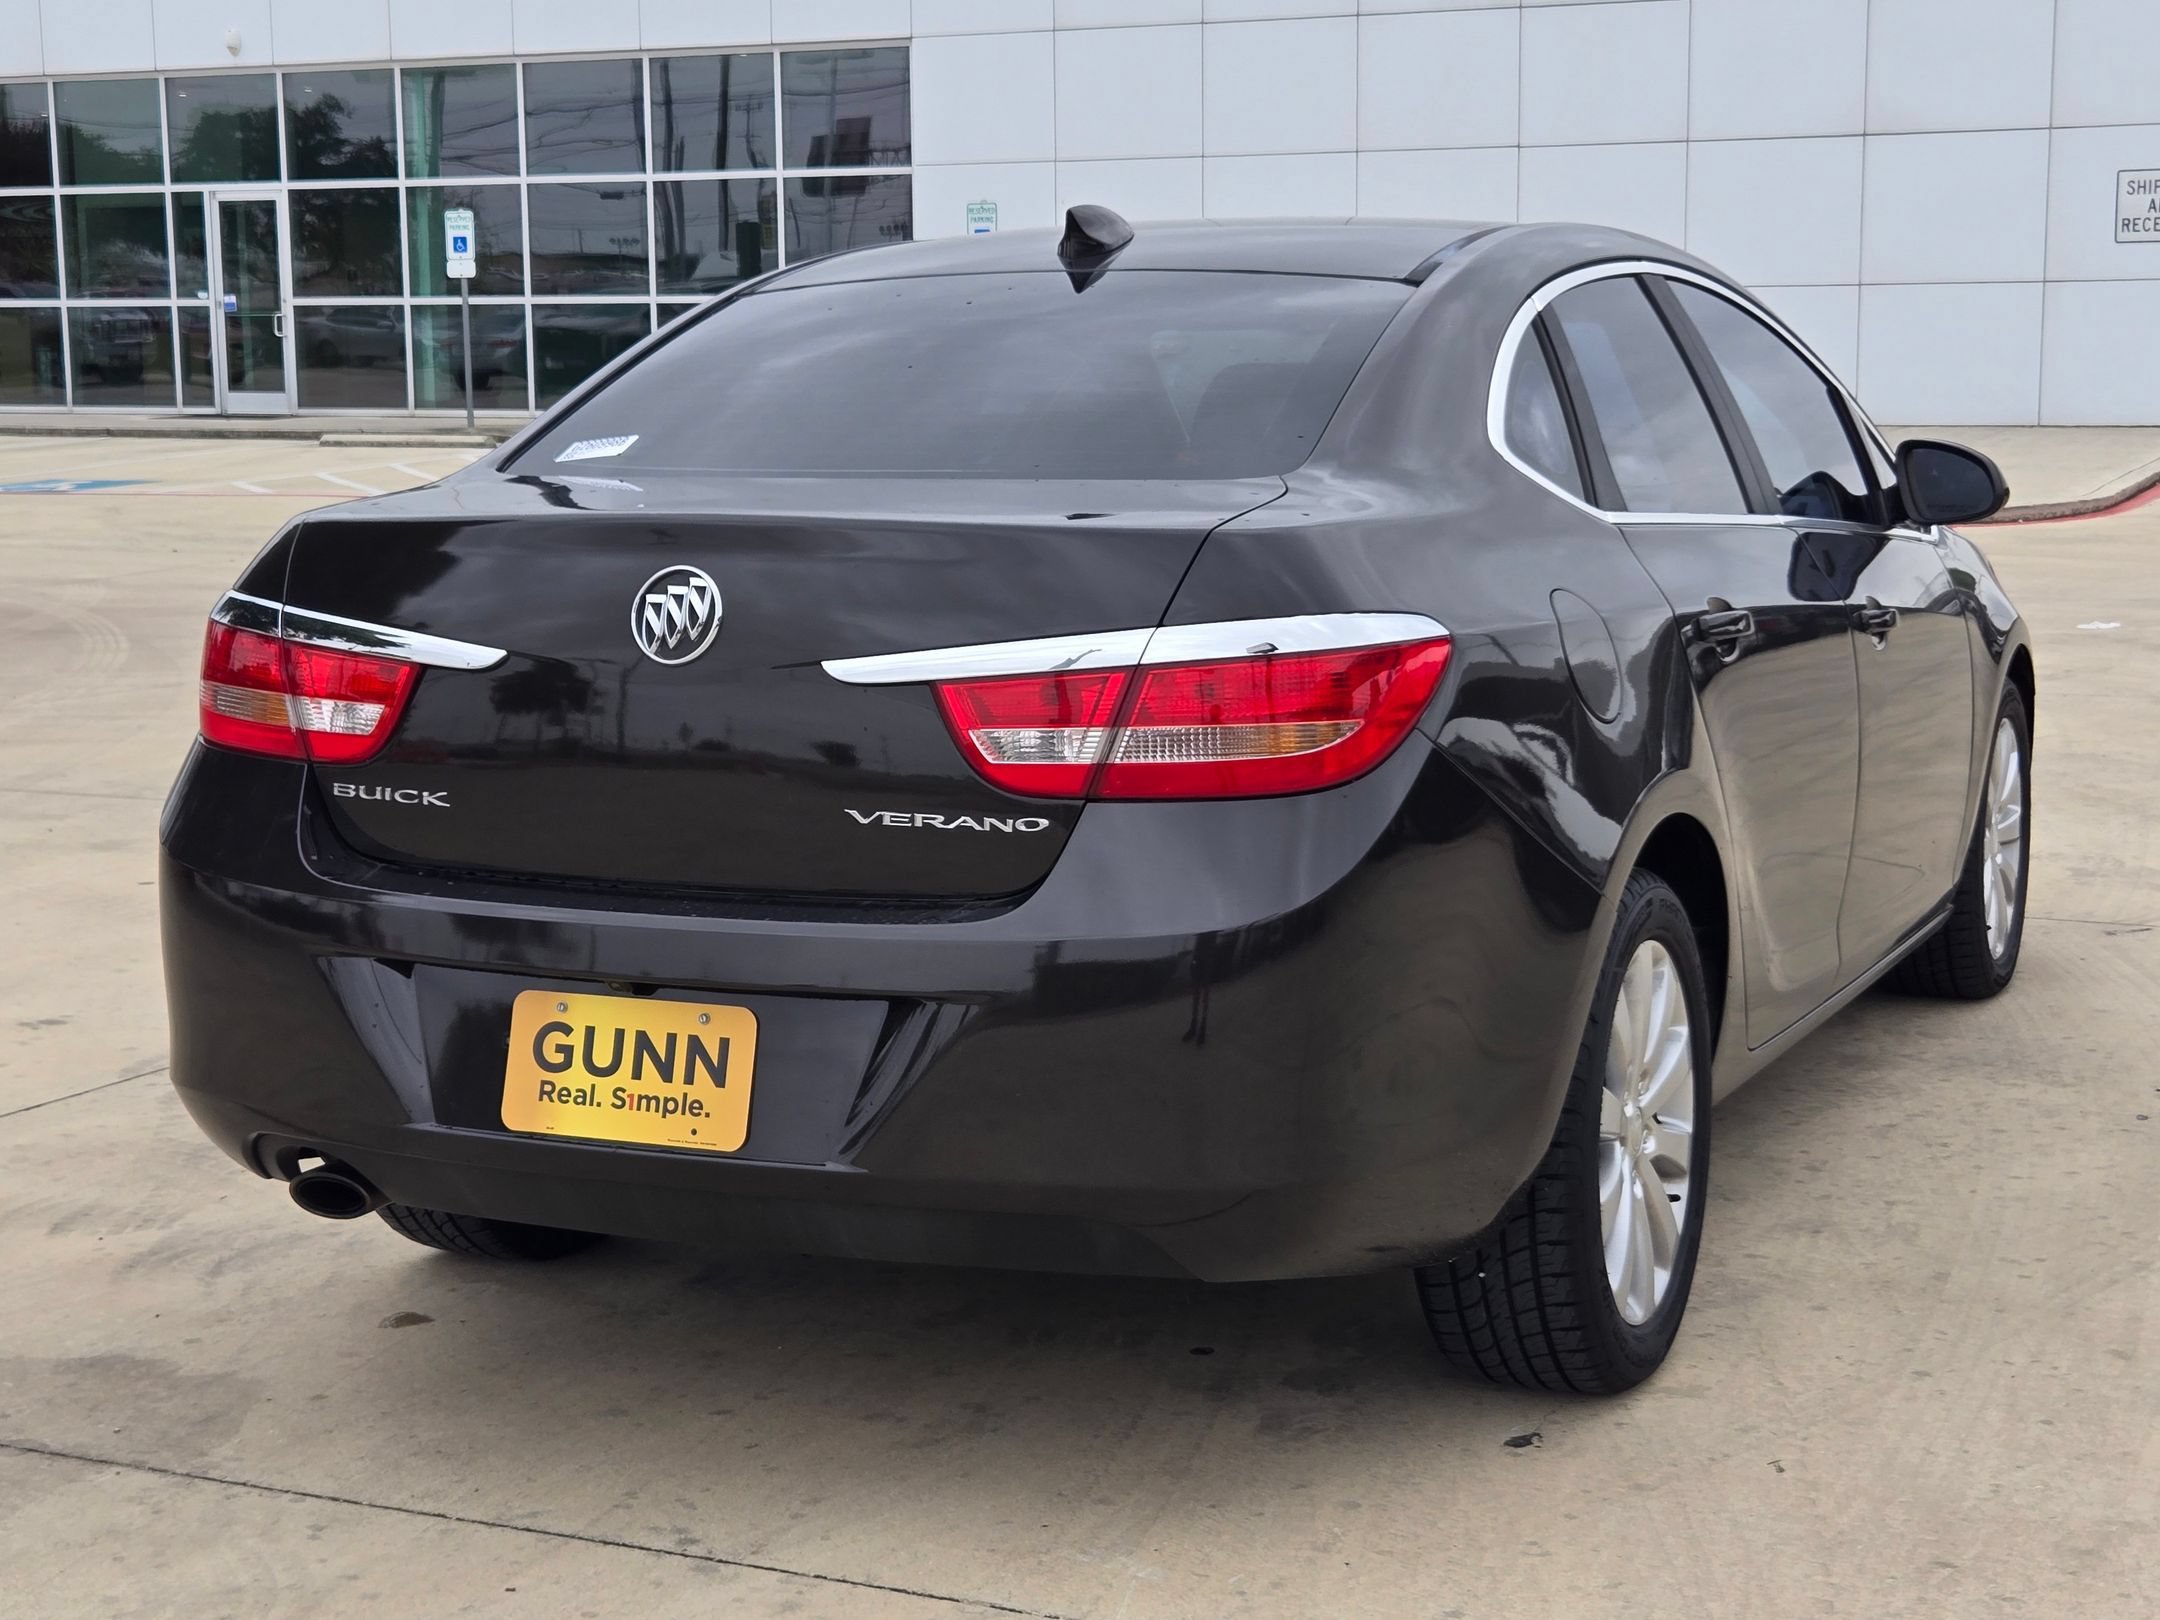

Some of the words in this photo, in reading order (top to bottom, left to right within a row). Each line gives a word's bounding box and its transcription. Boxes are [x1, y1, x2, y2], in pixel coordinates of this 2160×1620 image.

[332, 782, 451, 807] BUICK
[843, 809, 1050, 833] VERANO
[532, 1020, 731, 1088] GUNN
[537, 1079, 602, 1108] Real.
